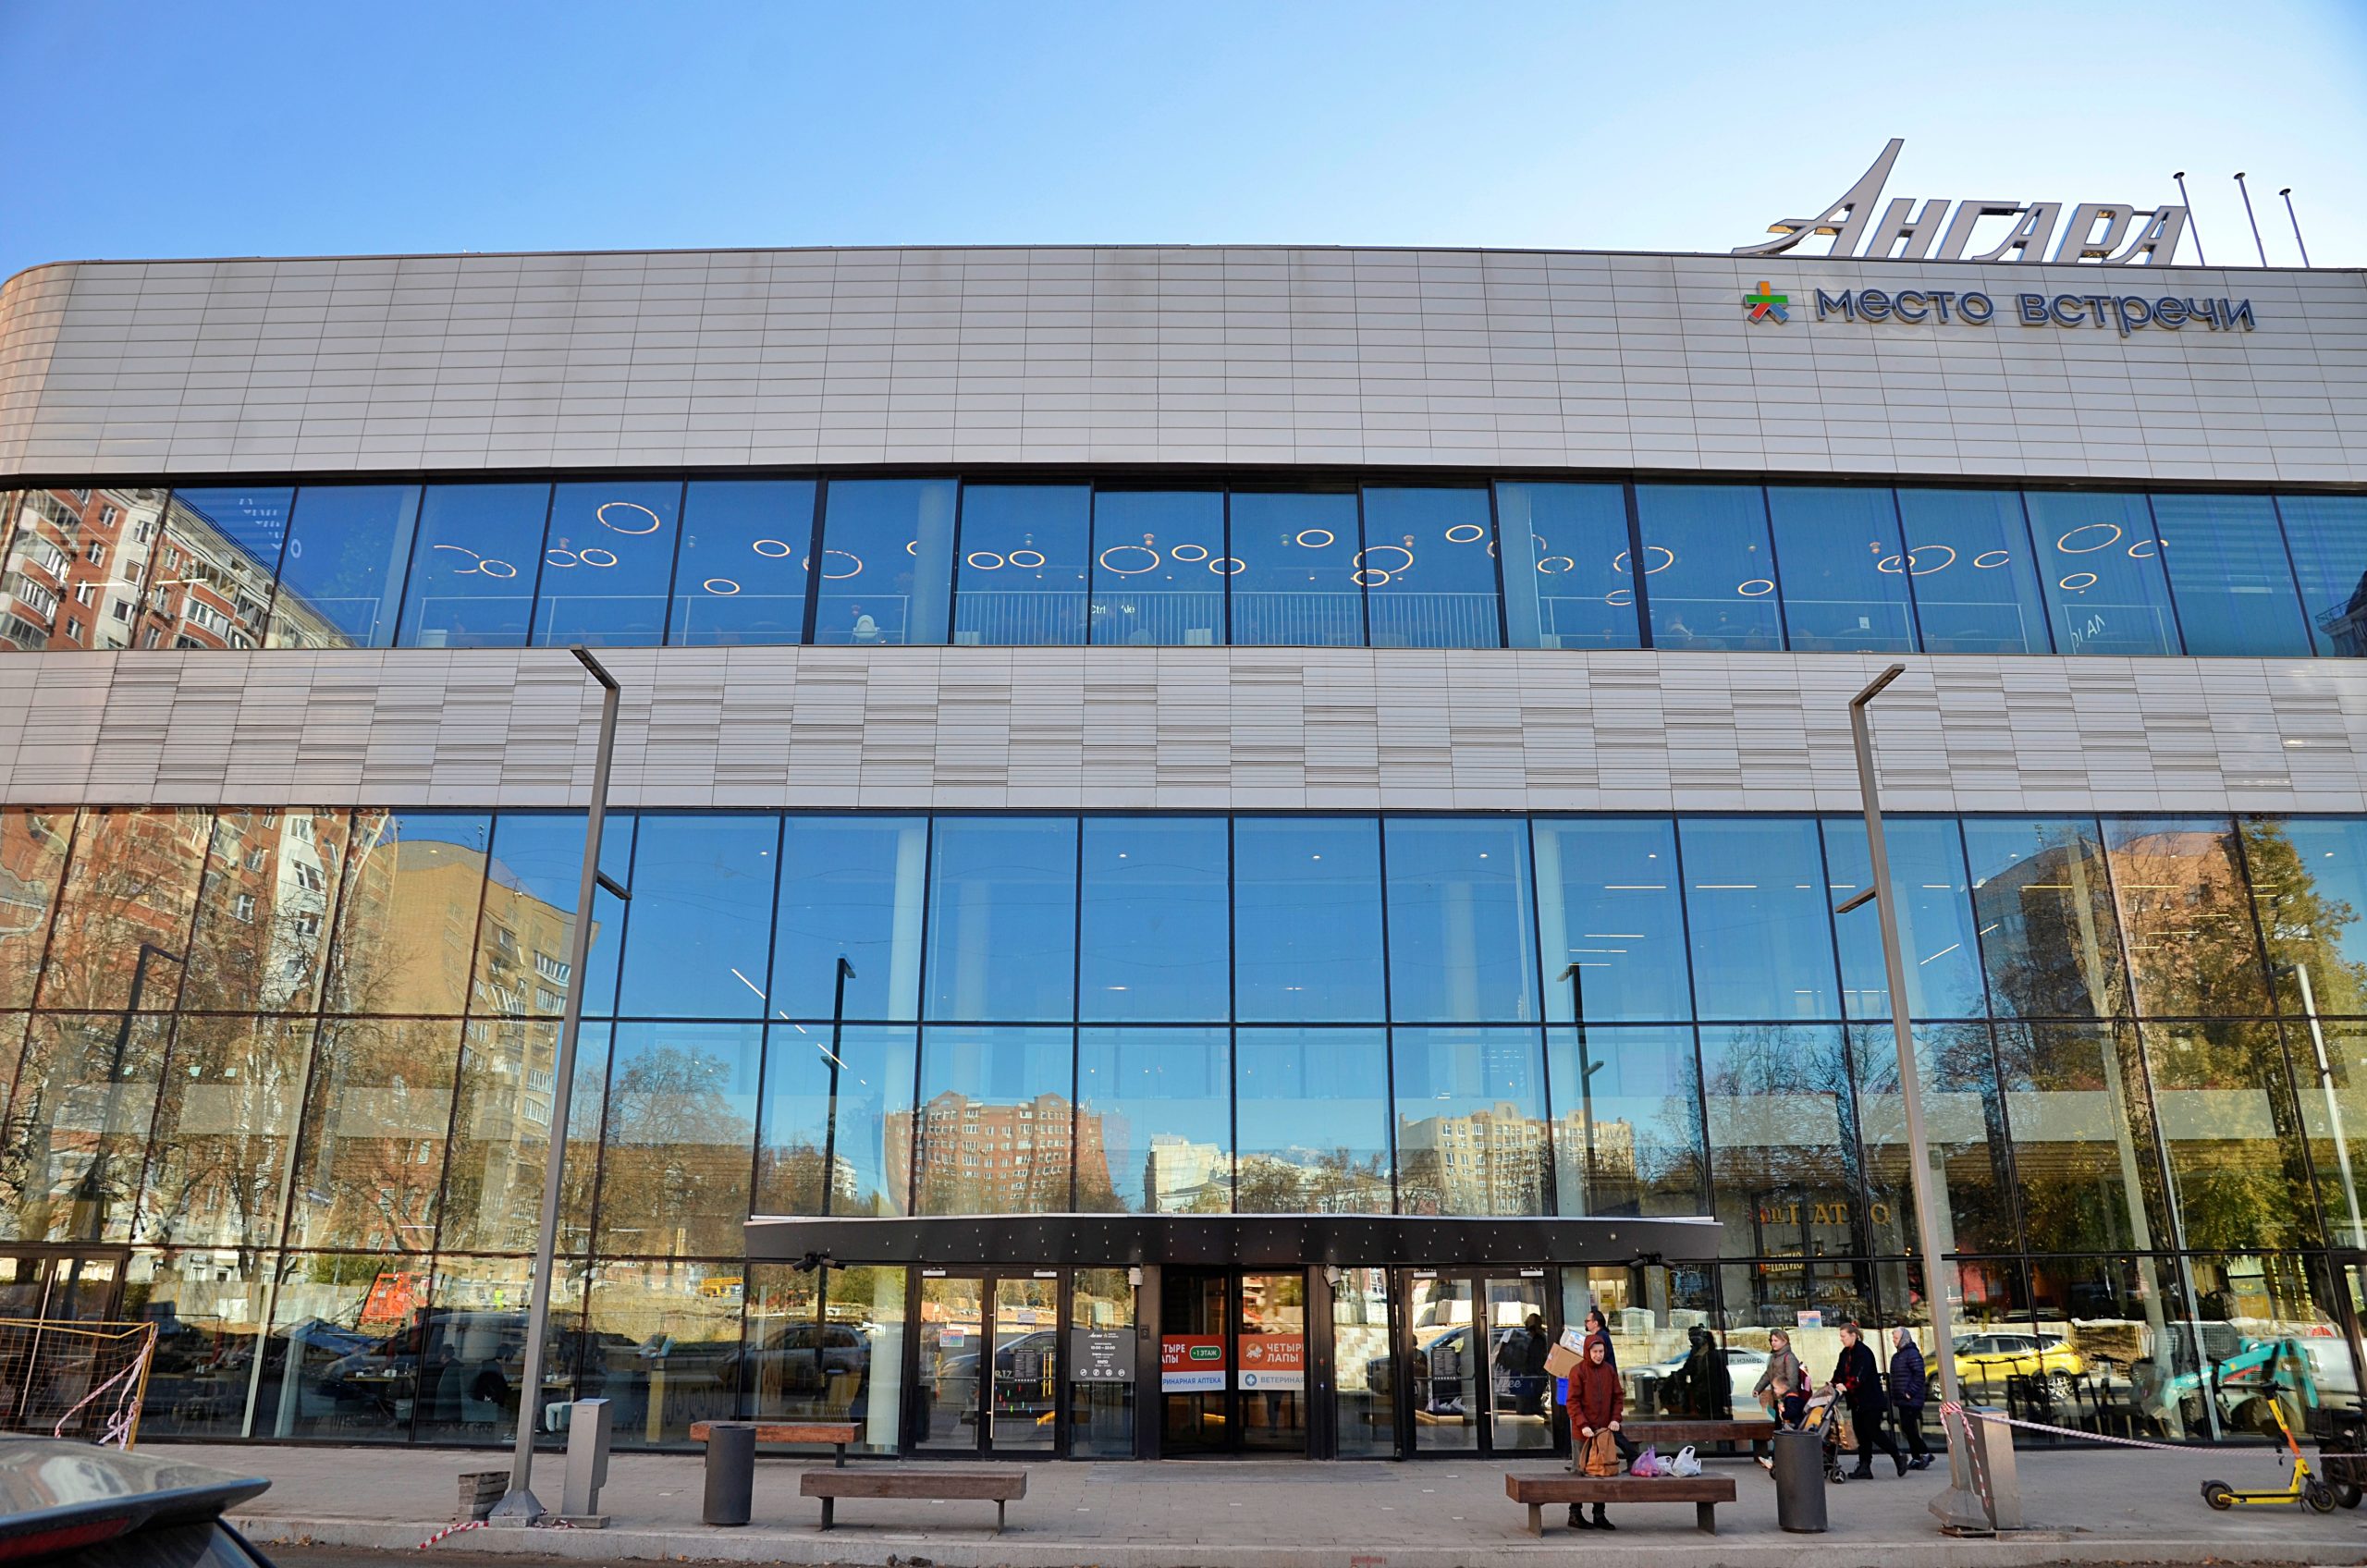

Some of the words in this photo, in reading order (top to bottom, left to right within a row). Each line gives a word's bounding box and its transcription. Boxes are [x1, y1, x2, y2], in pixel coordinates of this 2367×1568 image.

[1815, 288, 1994, 326] место
[2017, 293, 2256, 338] встречи
[1162, 1343, 1185, 1354] ТЫРЕ
[1267, 1353, 1299, 1363] ЛАПЫ
